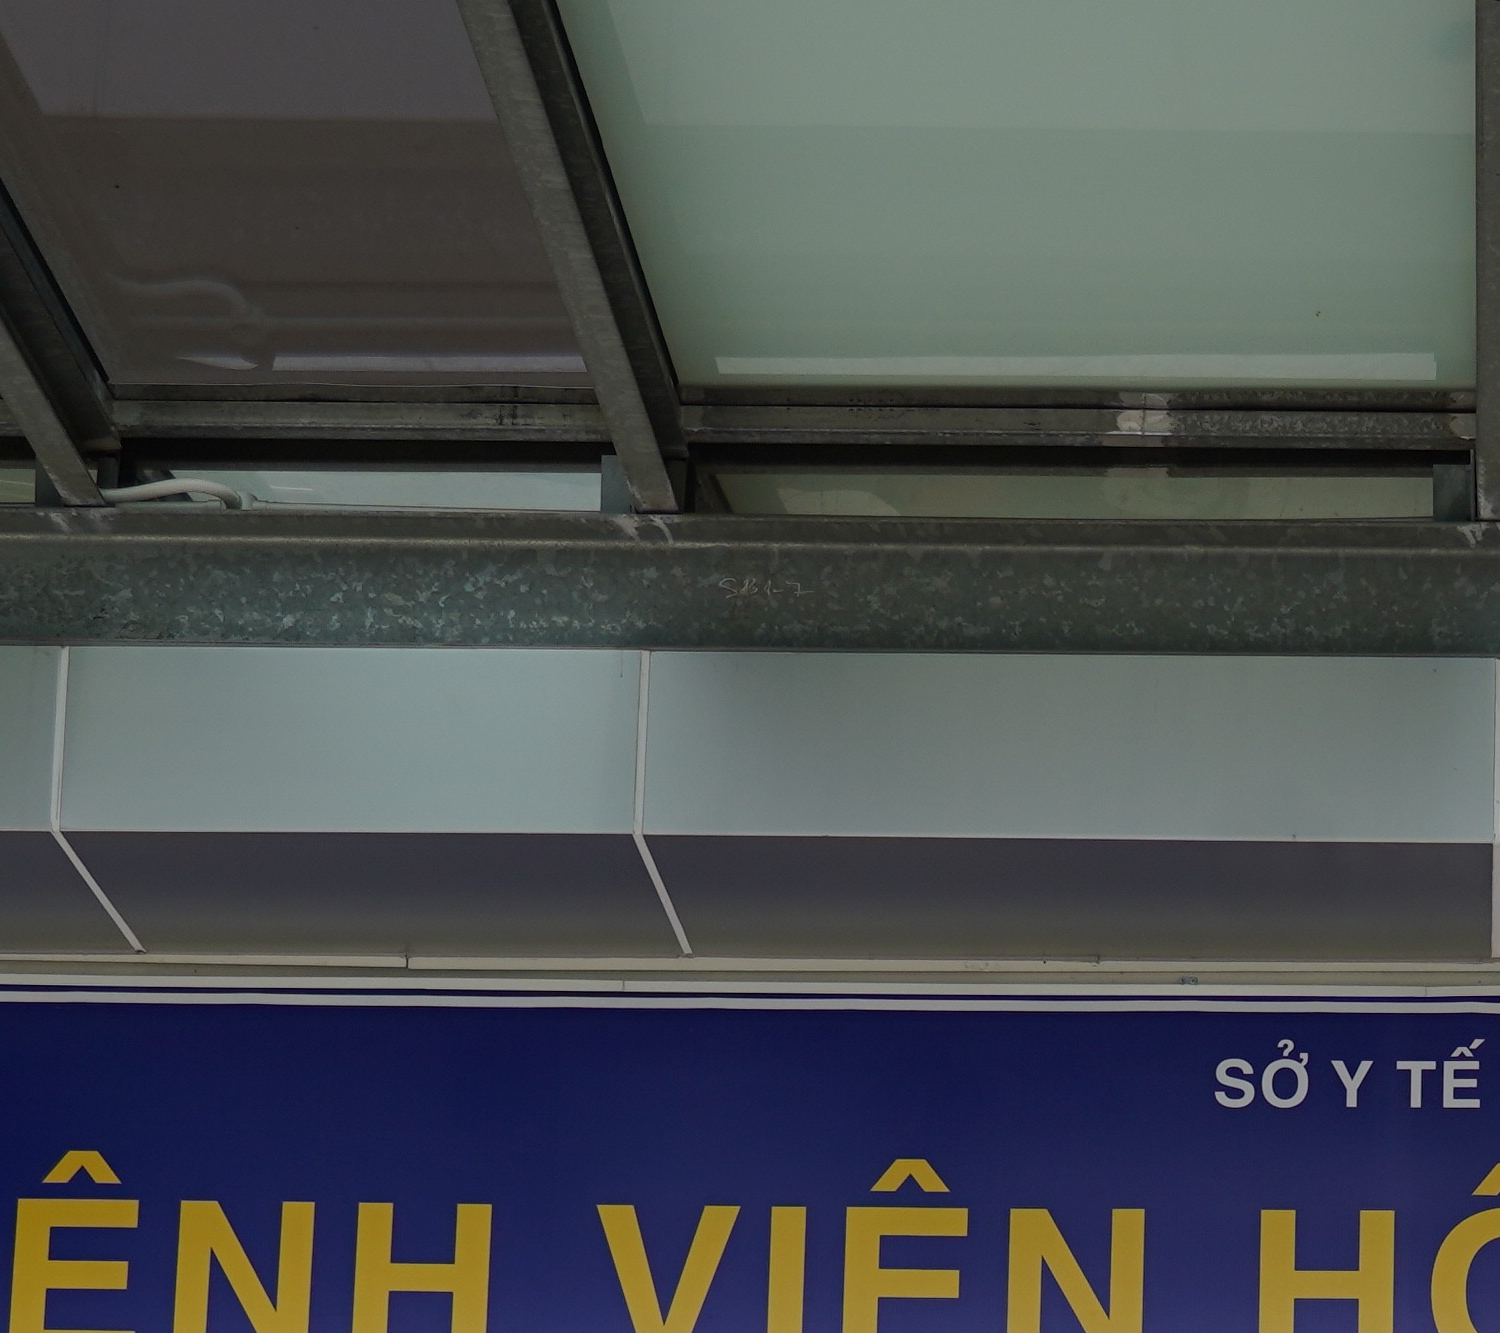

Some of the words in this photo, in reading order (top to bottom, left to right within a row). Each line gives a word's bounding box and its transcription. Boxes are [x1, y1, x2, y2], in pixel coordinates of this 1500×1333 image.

[1214, 1040, 1311, 1110] SỞ
[1331, 1059, 1374, 1110] Y
[1397, 1039, 1485, 1110] TẾ
